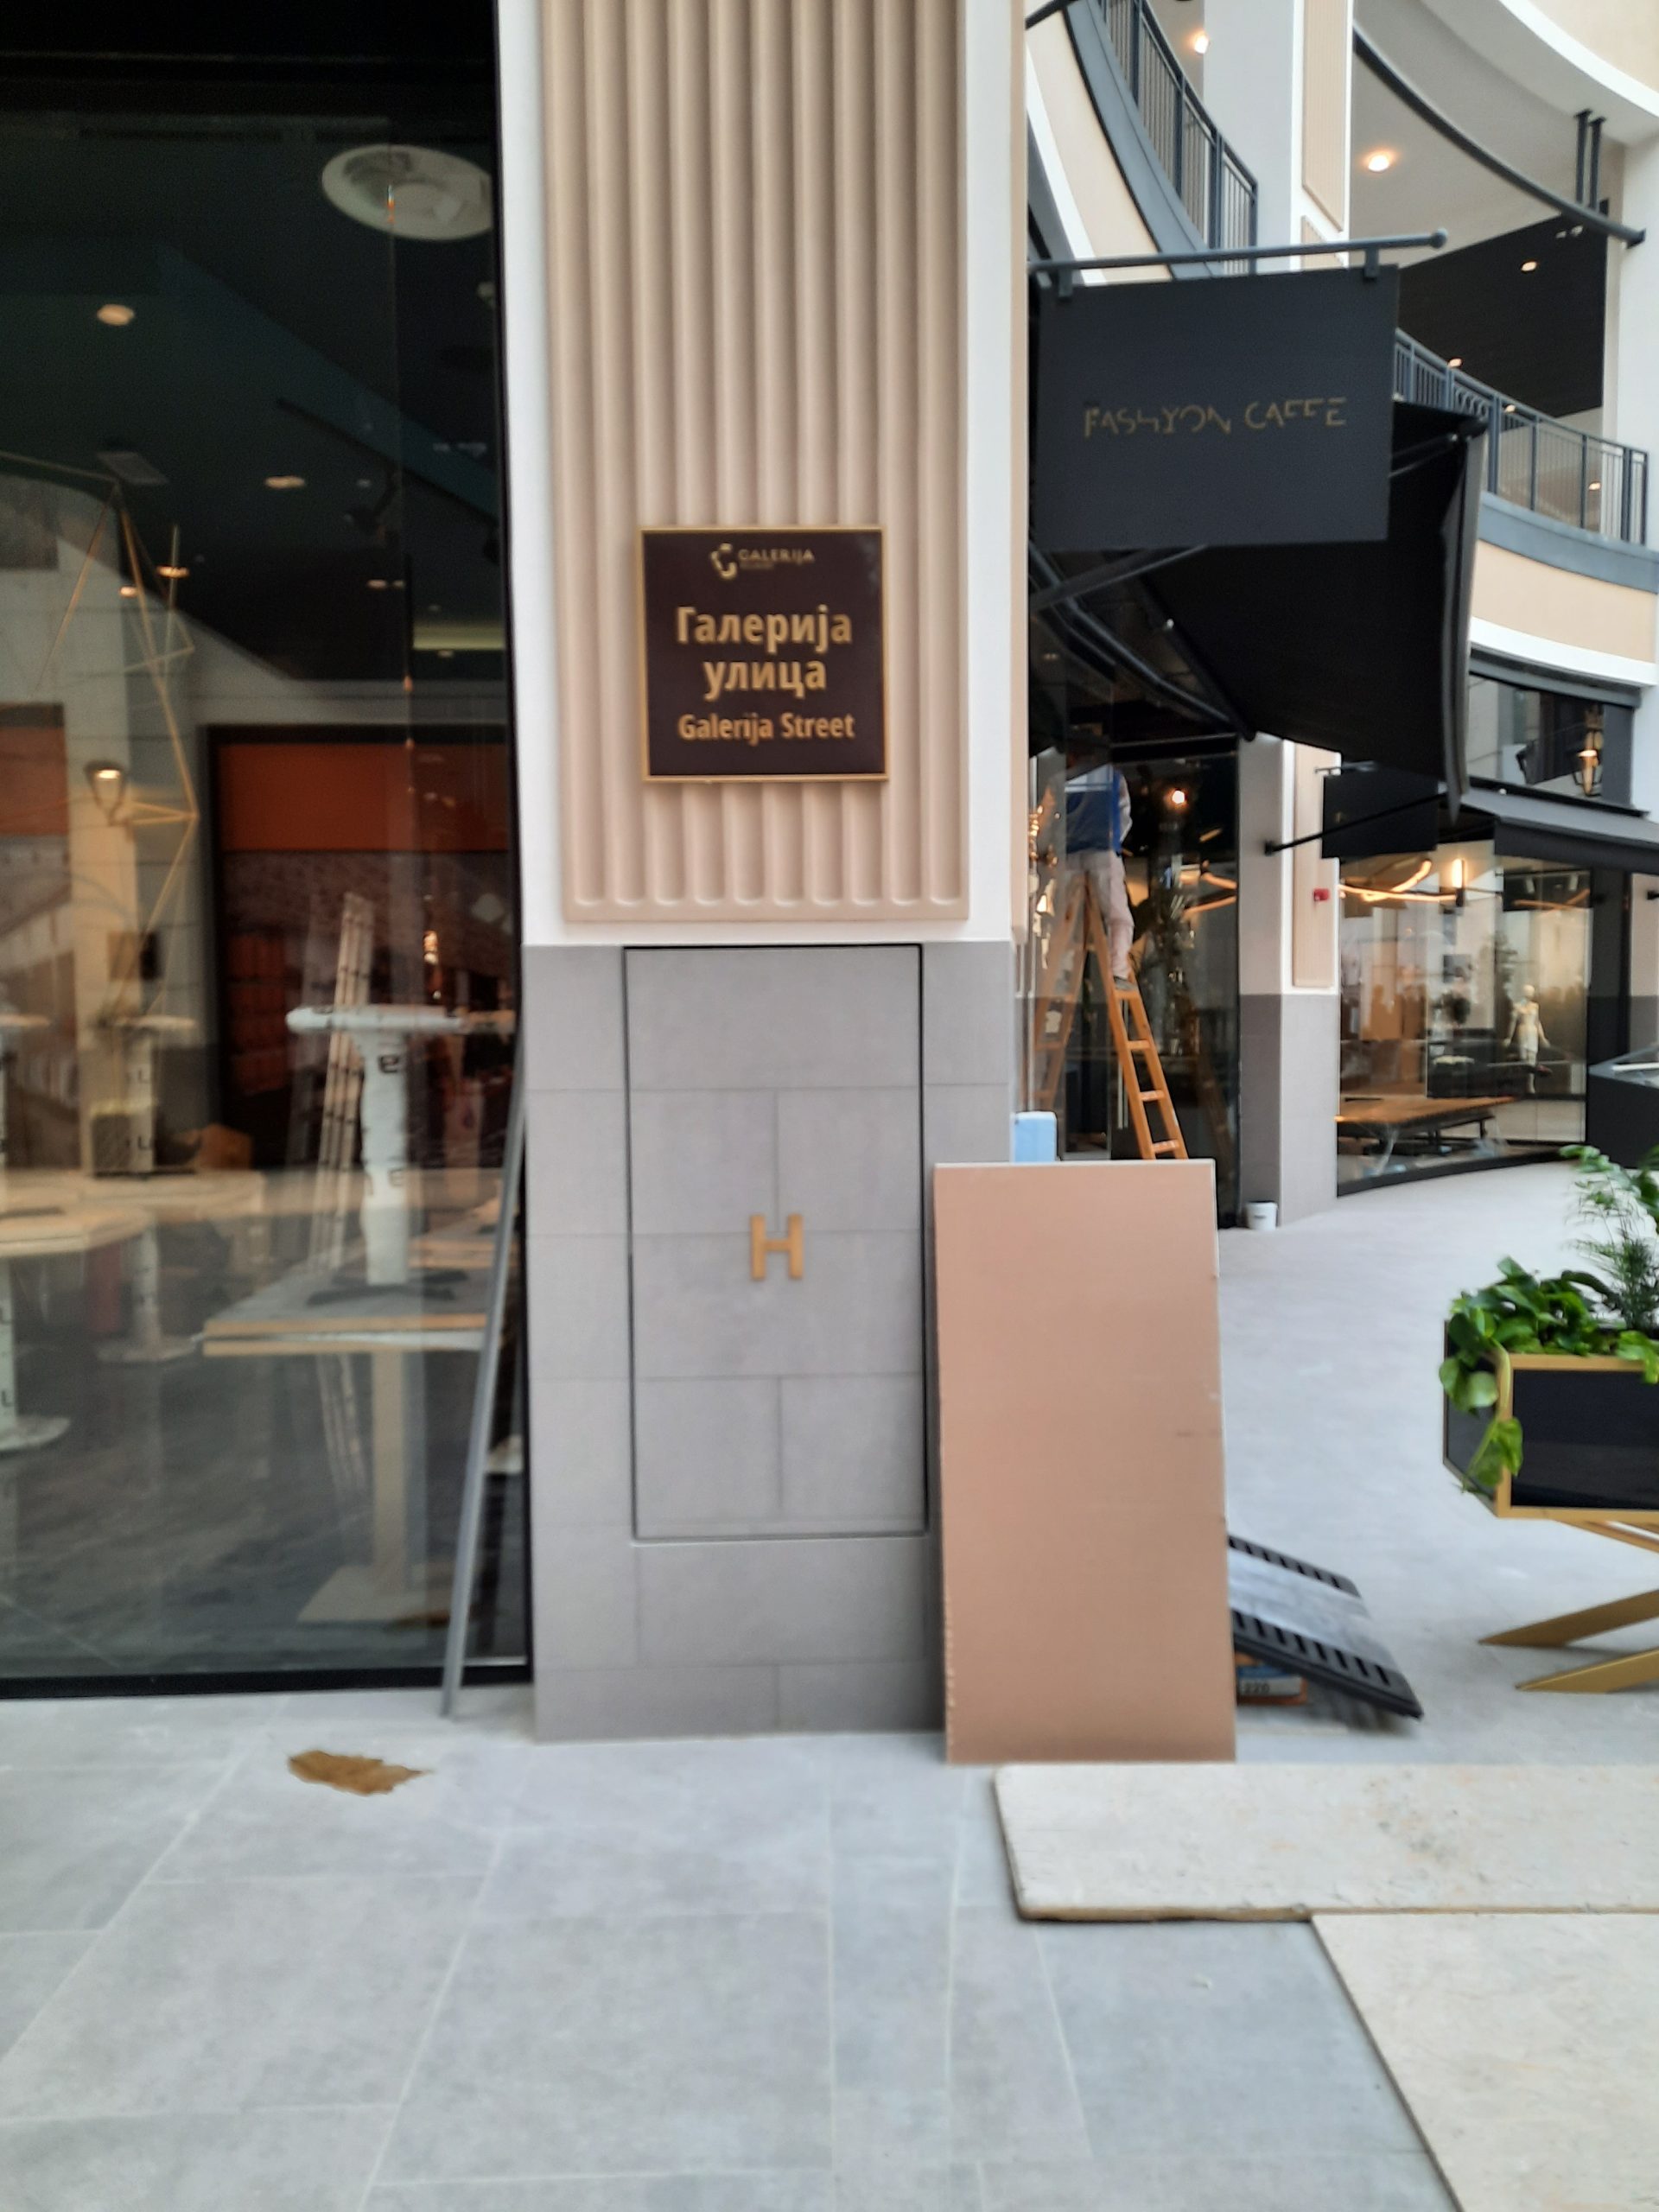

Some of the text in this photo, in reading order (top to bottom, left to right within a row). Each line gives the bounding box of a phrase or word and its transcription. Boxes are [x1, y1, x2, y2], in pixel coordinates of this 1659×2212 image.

[1244, 397, 1346, 429] CAFFE
[737, 549, 815, 564] GALERIJA
[677, 605, 853, 653] Галерија
[703, 658, 827, 702] улица
[677, 711, 855, 747] Galerija Street
[749, 1213, 804, 1281] H
